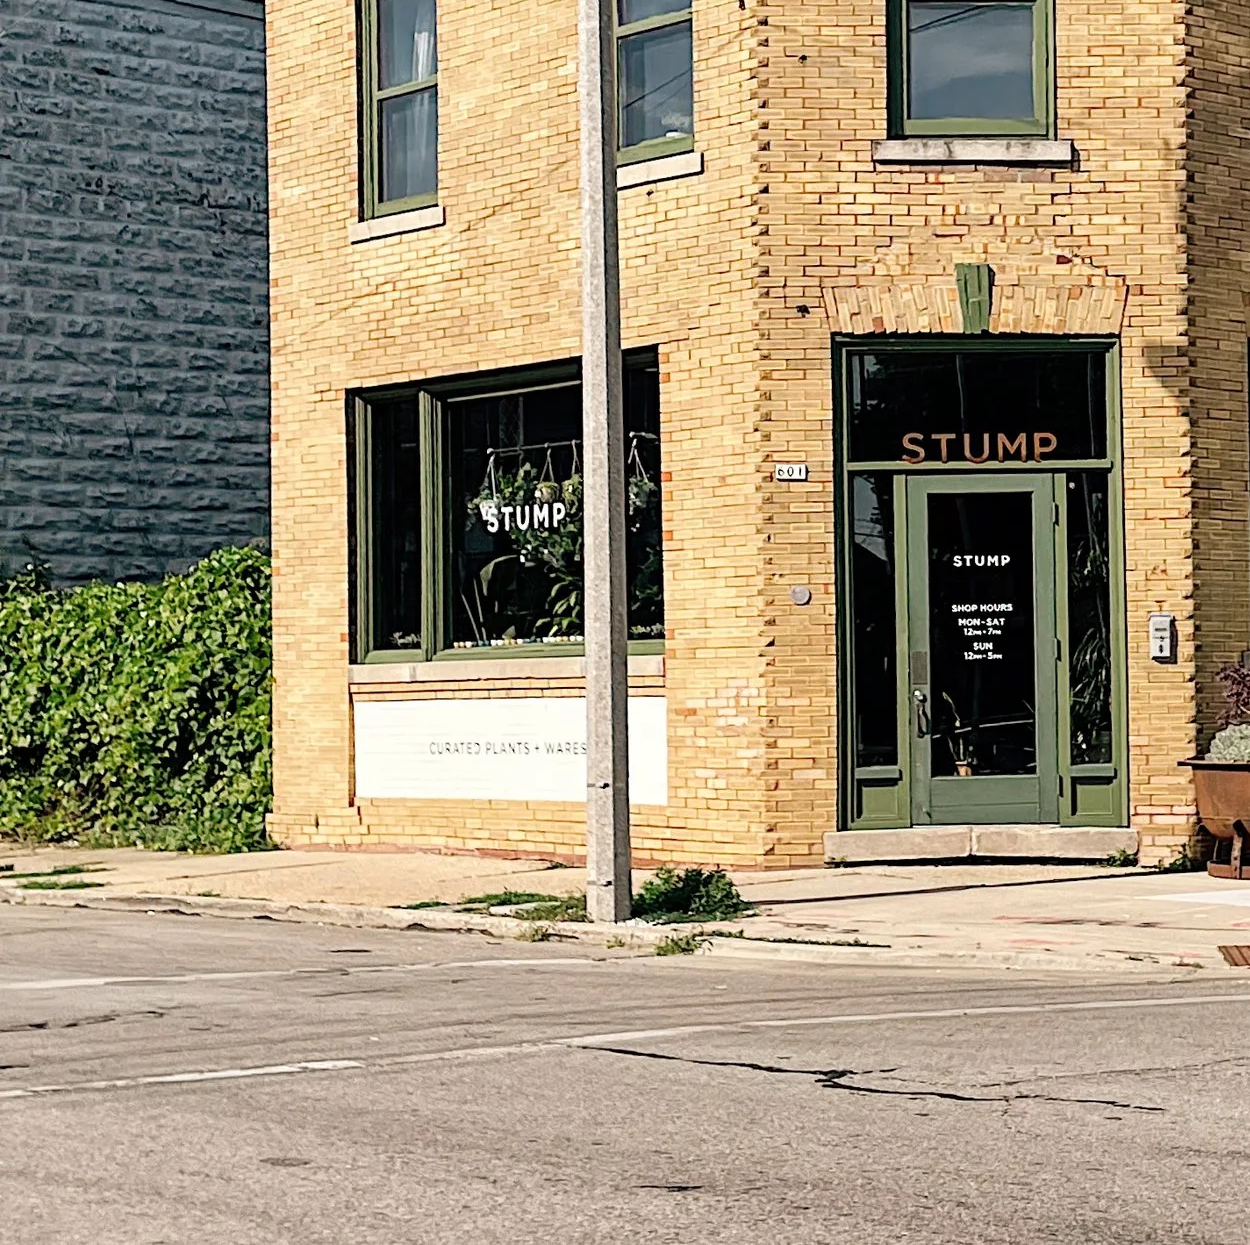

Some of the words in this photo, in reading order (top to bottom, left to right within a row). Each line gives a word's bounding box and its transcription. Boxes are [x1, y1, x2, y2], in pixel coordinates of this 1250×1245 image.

[902, 432, 1058, 464] STUMP
[777, 466, 803, 477] 601
[486, 502, 566, 533] STUMP
[953, 555, 1011, 567] STUMP
[951, 604, 978, 612] SHOP
[980, 603, 1013, 612] HOURS
[973, 642, 993, 650] SUN
[429, 741, 481, 755] CURATED
[485, 741, 530, 755] PLANTS
[544, 741, 587, 755] WARES
